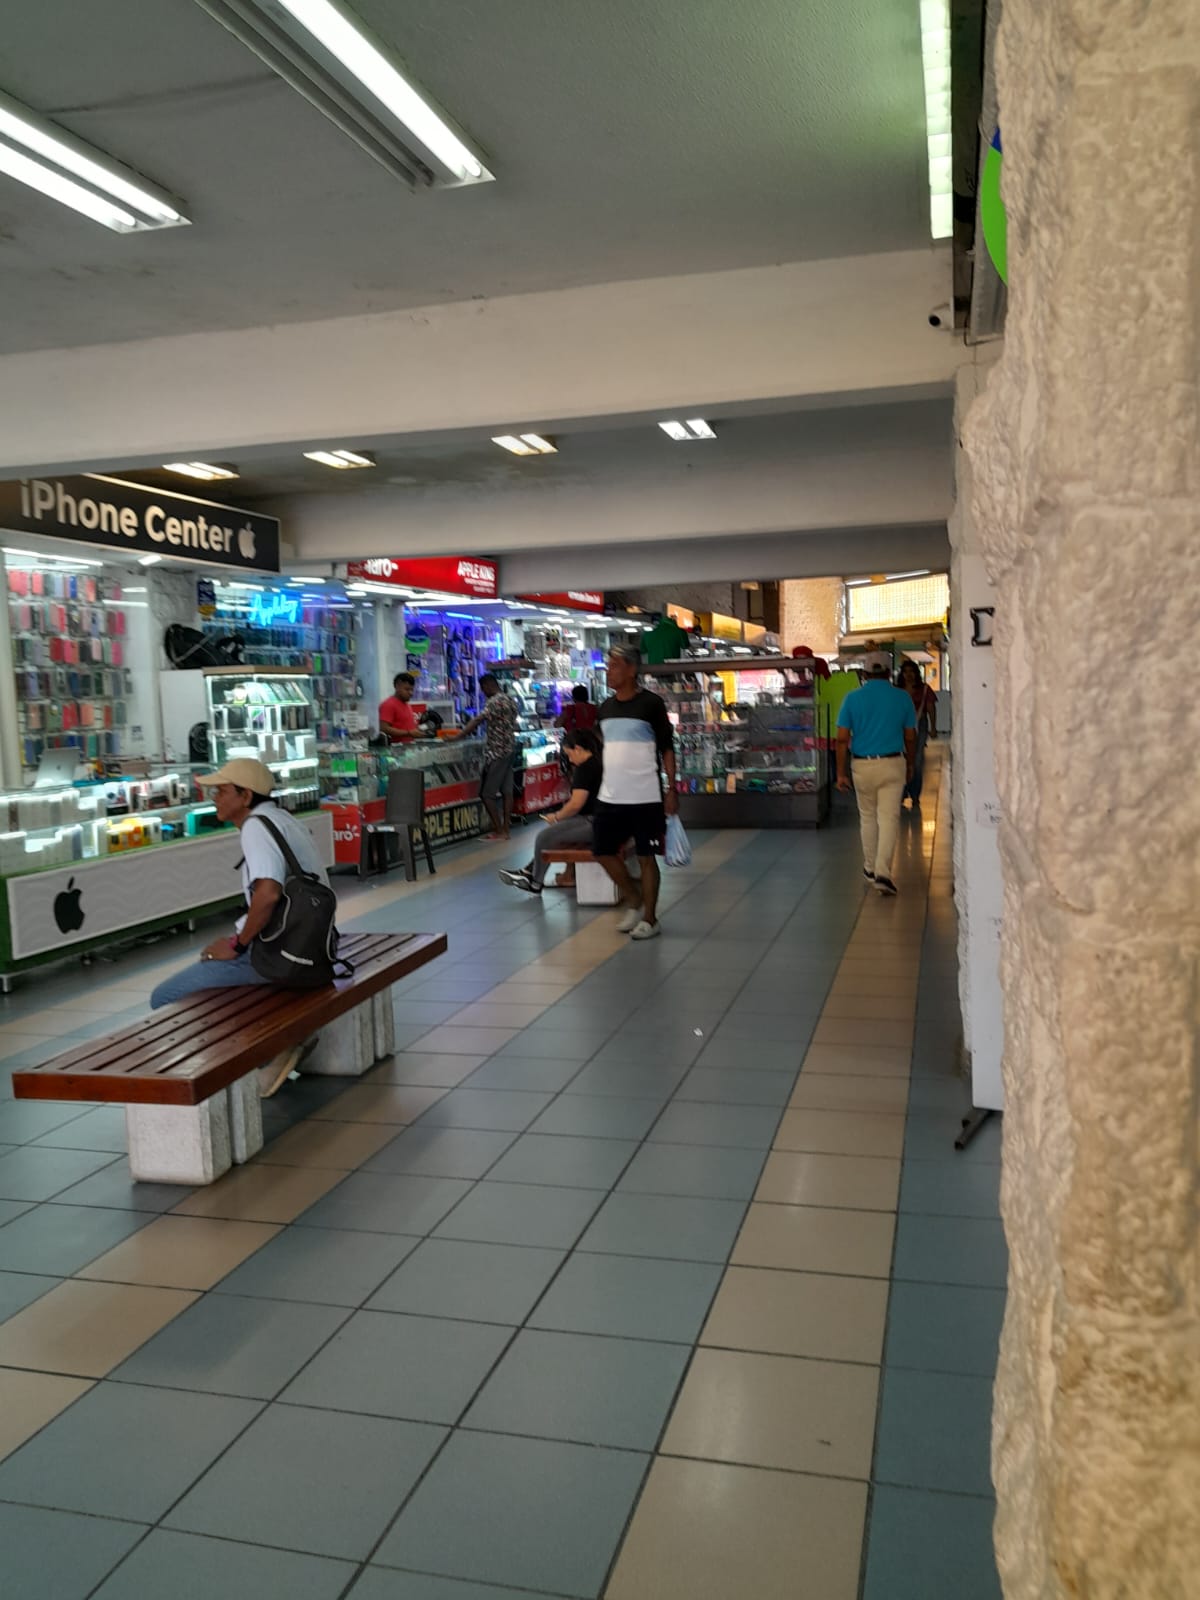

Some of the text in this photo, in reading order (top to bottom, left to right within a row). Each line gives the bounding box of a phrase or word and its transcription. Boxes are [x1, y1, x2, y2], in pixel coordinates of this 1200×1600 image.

[21, 480, 233, 552] iPhone Center
[453, 805, 479, 832] KING
